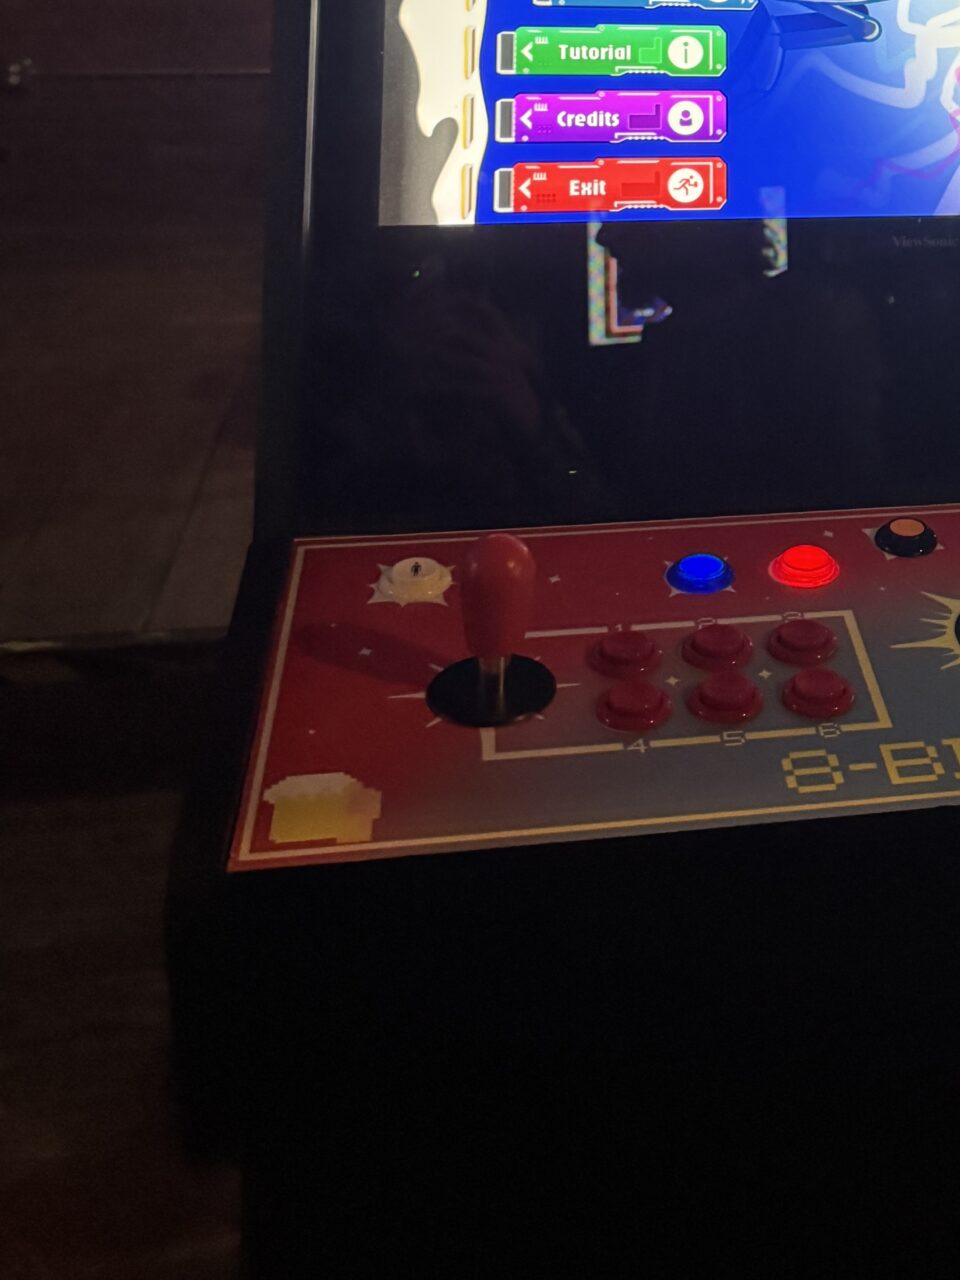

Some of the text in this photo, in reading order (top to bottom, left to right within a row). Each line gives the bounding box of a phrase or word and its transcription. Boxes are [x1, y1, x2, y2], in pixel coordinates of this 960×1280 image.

[558, 44, 632, 61] Tutorial
[556, 110, 620, 127] Credits
[568, 179, 607, 196] Exit
[817, 721, 842, 738] 6
[625, 738, 649, 754] 4
[721, 730, 747, 747] 5
